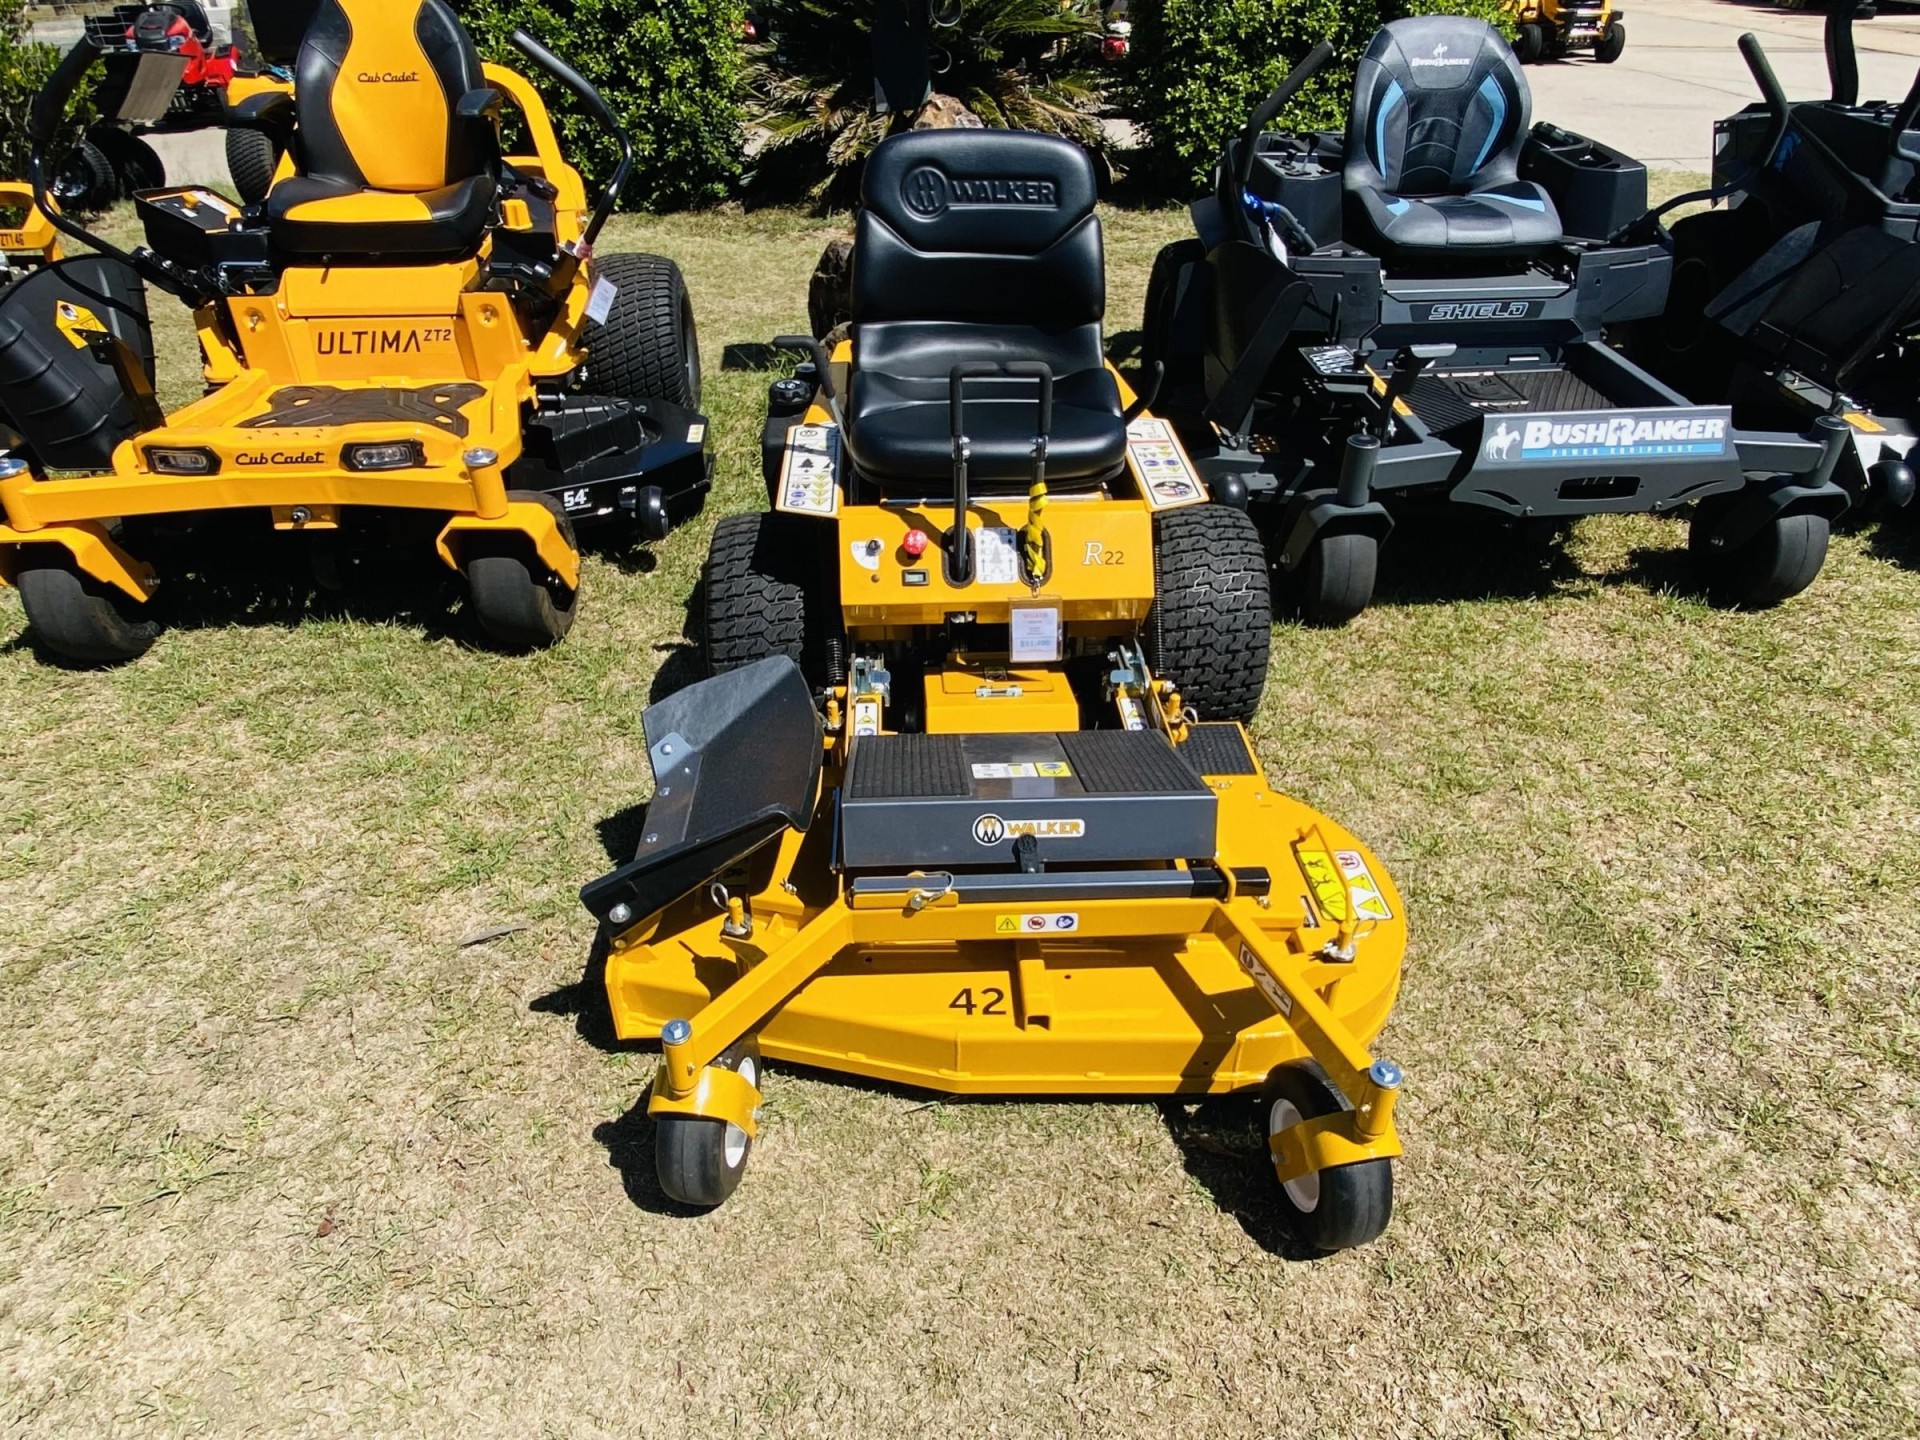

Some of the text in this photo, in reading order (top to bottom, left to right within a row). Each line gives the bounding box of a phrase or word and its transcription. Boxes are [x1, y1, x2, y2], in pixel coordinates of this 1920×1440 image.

[357, 72, 420, 83] Cub Cadet
[951, 180, 1056, 202] WALKER
[1428, 302, 1529, 320] SHIELD
[317, 329, 452, 354] ULTIMA ZT2
[235, 451, 325, 465] Cub Cadet
[1552, 445, 1694, 457] POWER EQUIPMENT
[563, 488, 589, 507] 54"
[1007, 821, 1082, 836] WALKER
[948, 987, 1007, 1016] 42
